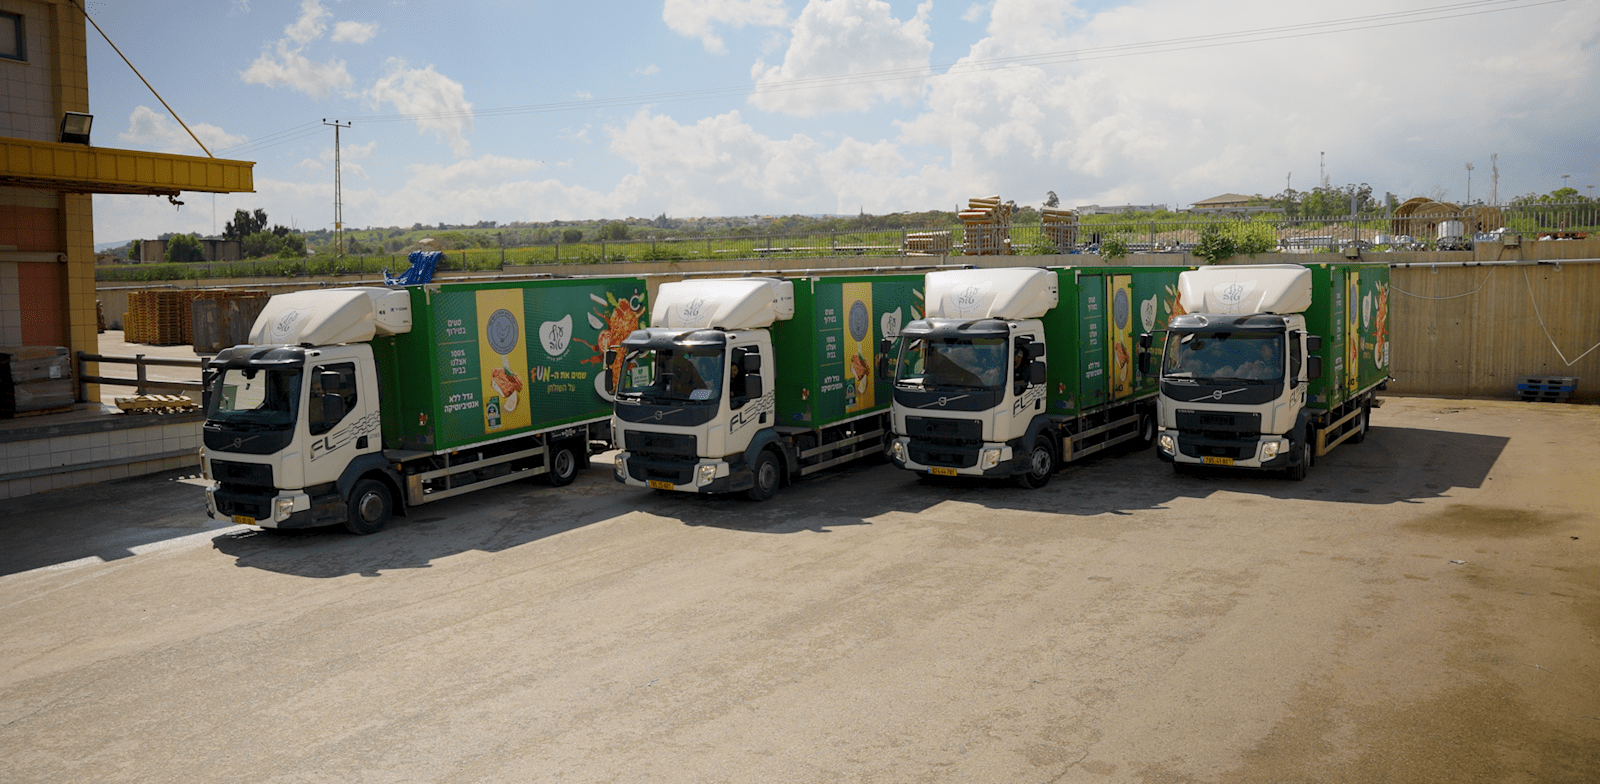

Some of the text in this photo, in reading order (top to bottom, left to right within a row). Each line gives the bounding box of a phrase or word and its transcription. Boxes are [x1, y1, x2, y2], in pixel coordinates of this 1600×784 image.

[446, 327, 466, 337] בטירוף
[549, 324, 564, 342] עוף
[549, 341, 564, 351] טוב
[450, 358, 467, 366] אצלנו
[452, 367, 467, 375] בבית
[449, 392, 473, 403] גדל ללא
[444, 400, 479, 413] אנטיביוטיקה
[730, 414, 747, 432] FL
[310, 436, 336, 459] FL
